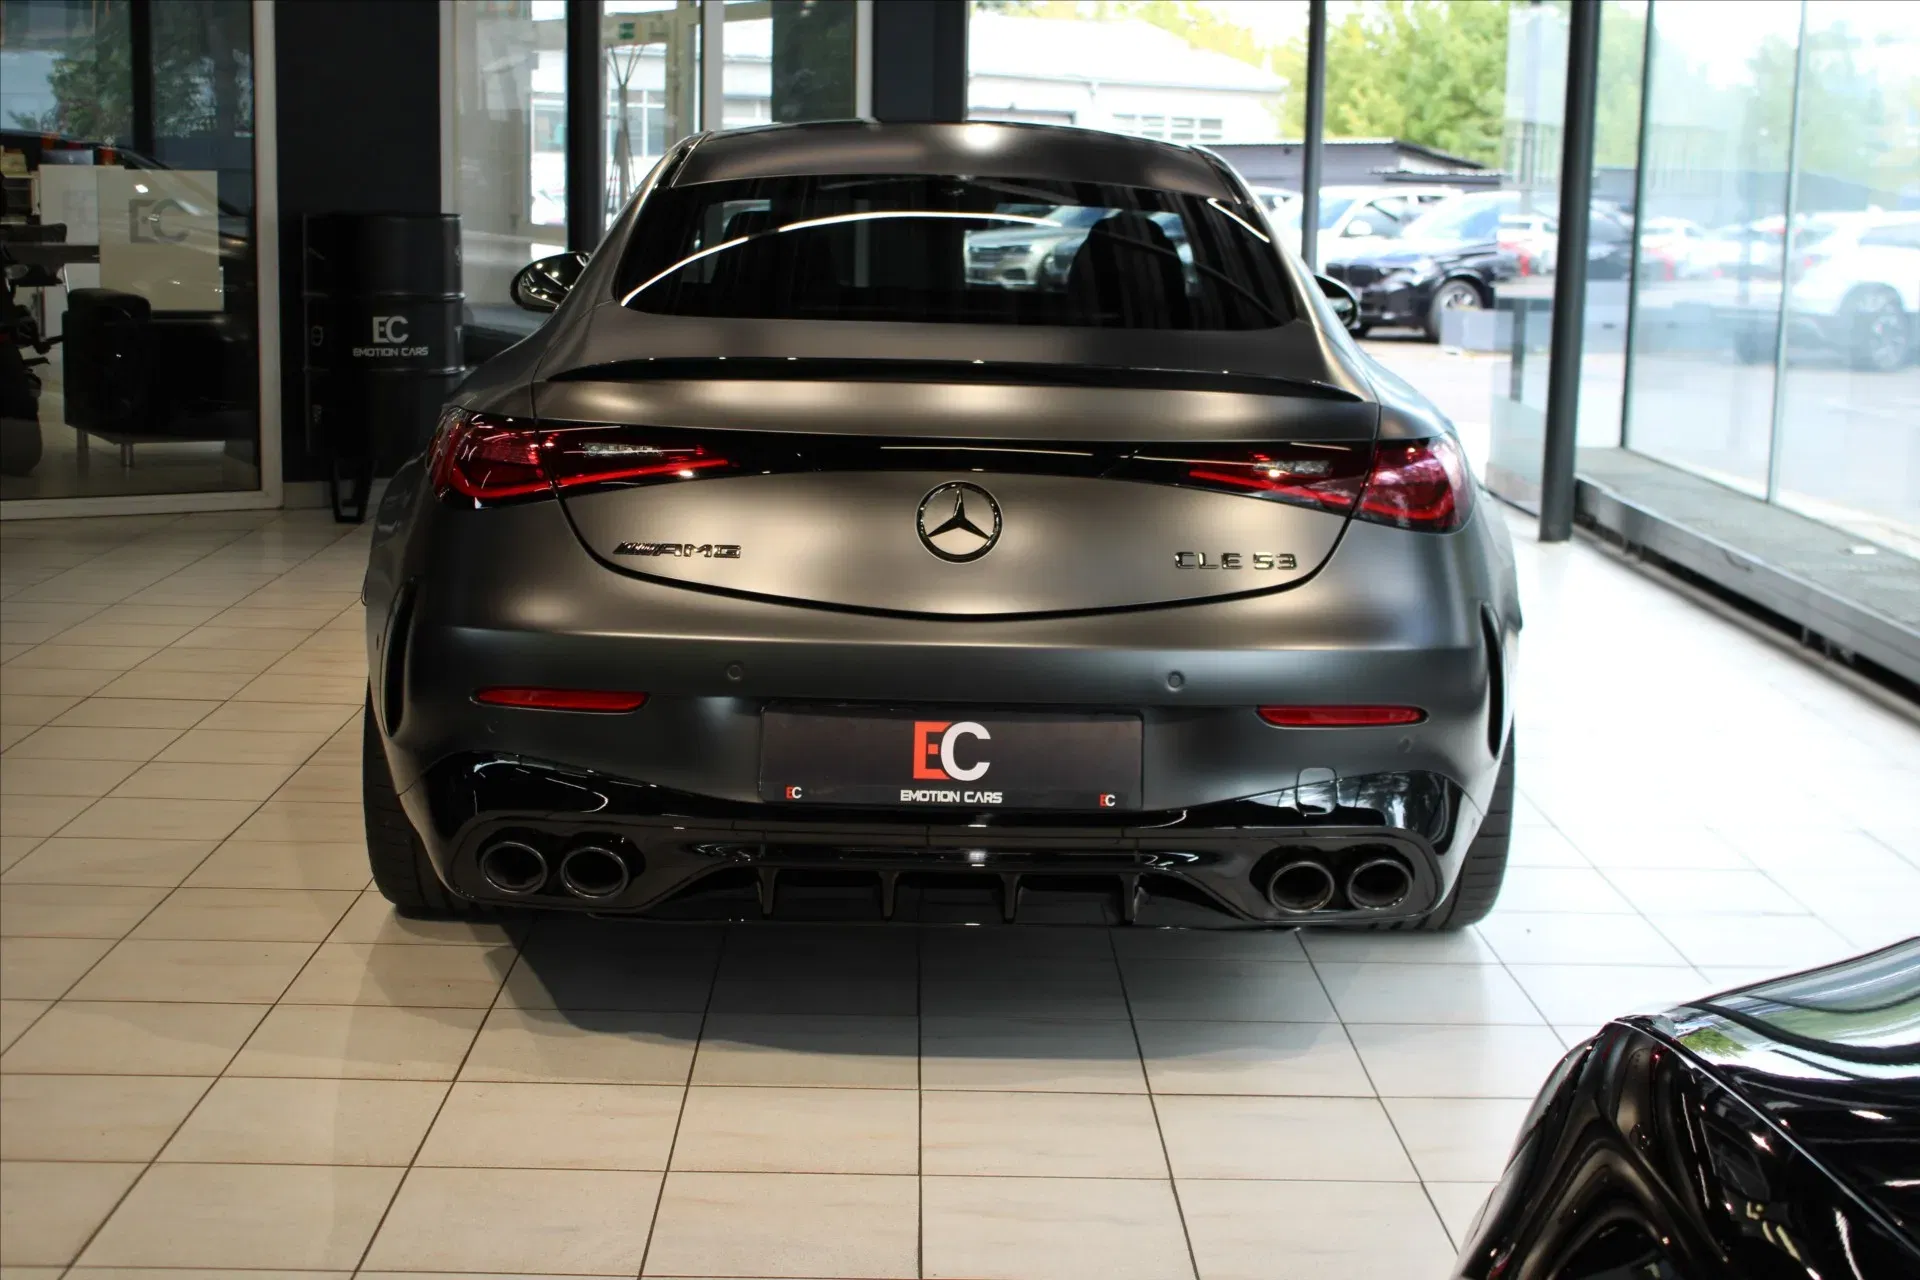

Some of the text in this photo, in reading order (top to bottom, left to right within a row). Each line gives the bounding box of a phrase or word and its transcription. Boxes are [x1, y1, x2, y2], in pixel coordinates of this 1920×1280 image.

[129, 199, 189, 243] EC
[372, 315, 409, 344] EC
[352, 346, 429, 357] EMOTION CARS
[651, 543, 742, 559] AMG
[1175, 551, 1297, 570] CLE 53
[913, 721, 991, 781] EC
[786, 786, 802, 799] EC
[900, 789, 1003, 804] EMOTION CARS
[1100, 794, 1116, 807] EC
